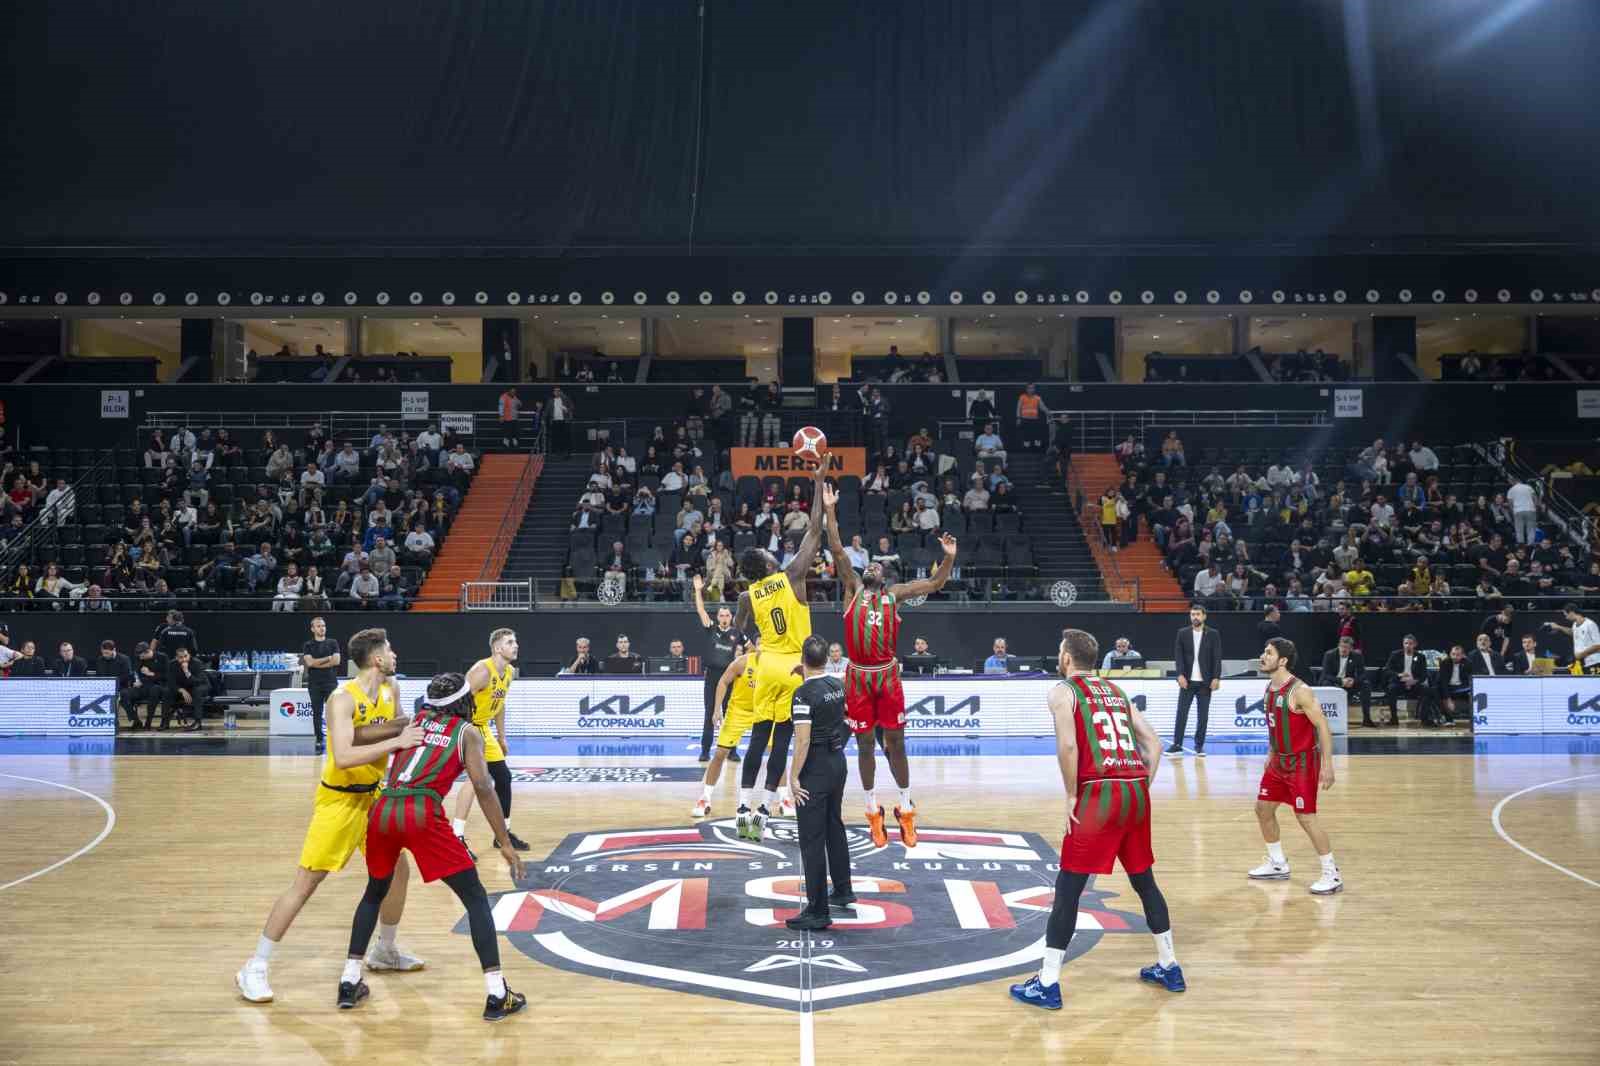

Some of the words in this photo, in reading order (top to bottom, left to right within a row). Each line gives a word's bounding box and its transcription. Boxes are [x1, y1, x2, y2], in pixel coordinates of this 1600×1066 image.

[754, 455, 844, 471] MERSN
[868, 610, 882, 627] 32
[579, 695, 665, 715] KIA
[577, 717, 665, 728] ÖZTOPRAKLAR
[1092, 711, 1135, 751] 35
[775, 940, 835, 949] 2019
